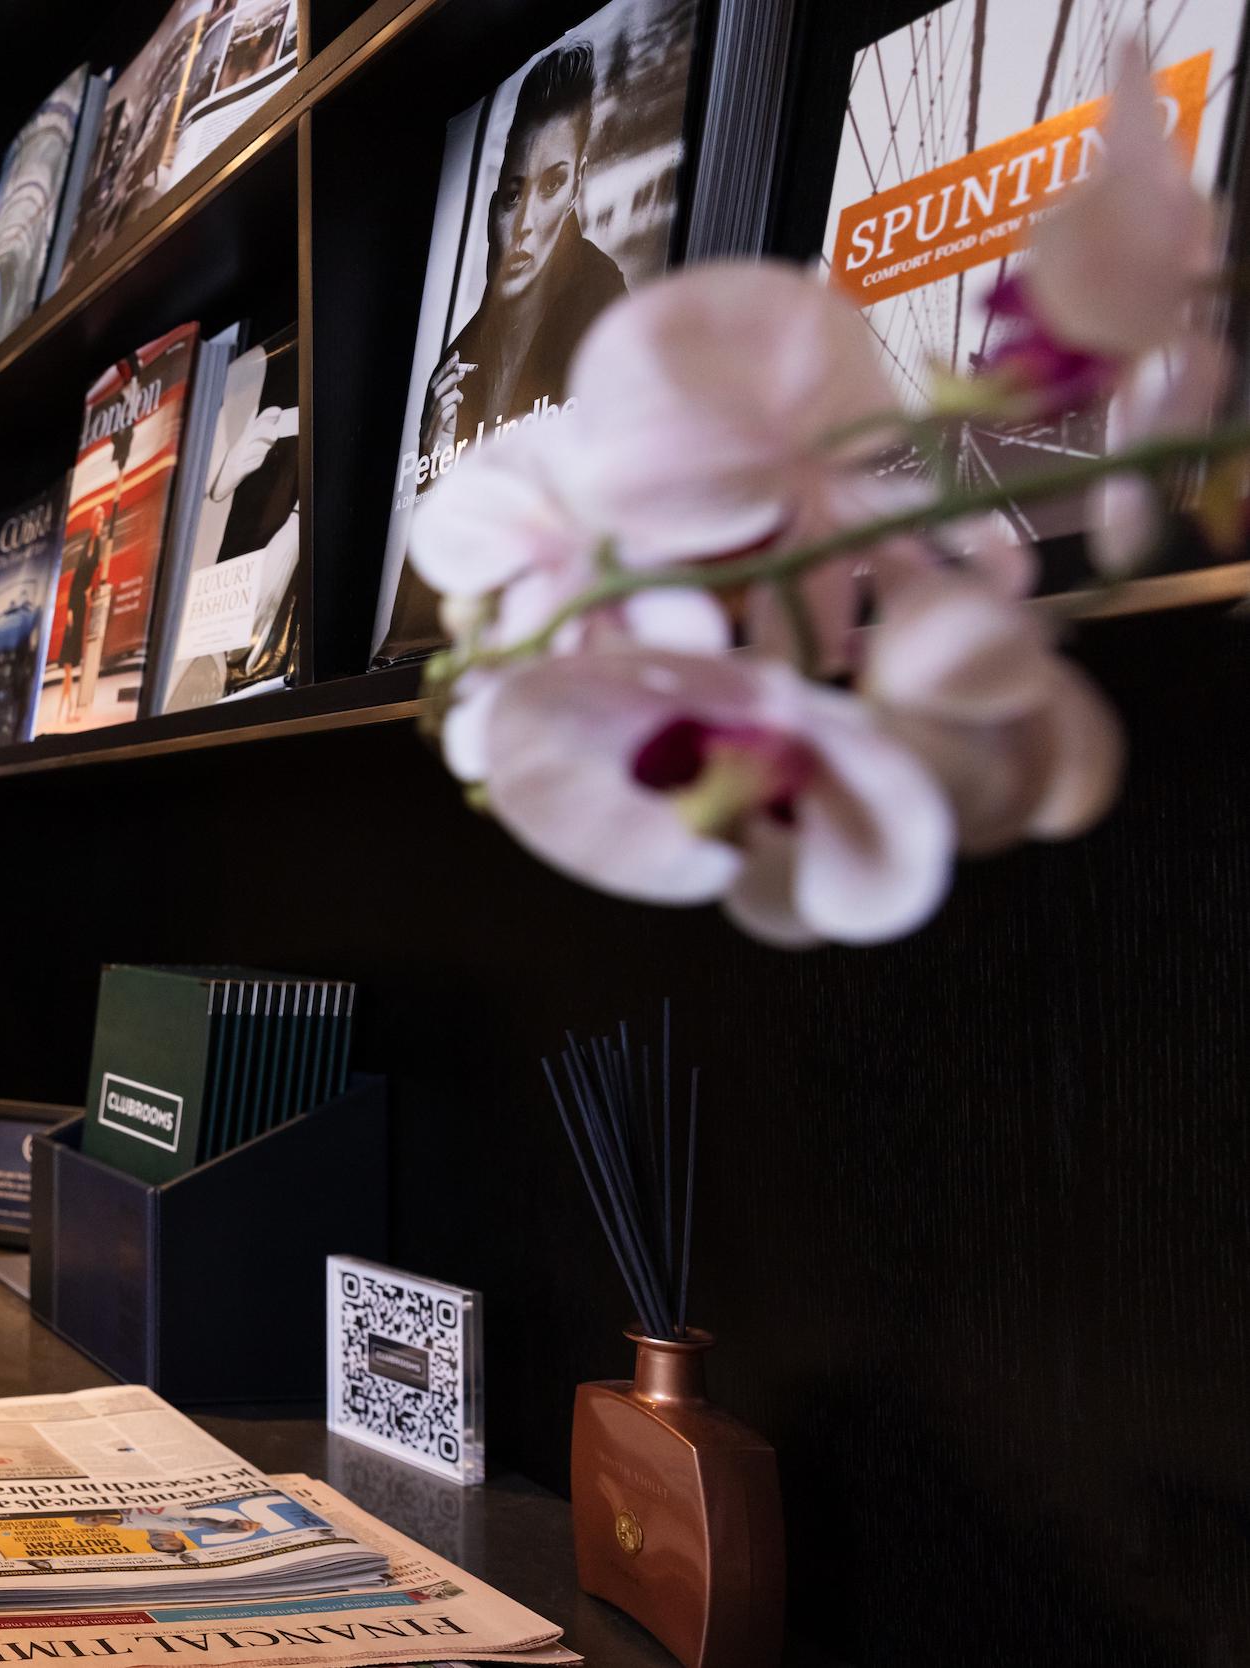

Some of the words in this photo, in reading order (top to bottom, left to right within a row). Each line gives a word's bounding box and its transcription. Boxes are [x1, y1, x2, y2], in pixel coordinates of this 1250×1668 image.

[862, 251, 932, 287] COMFORT
[934, 235, 978, 261] FOOD
[981, 216, 1024, 246] (NEW
[79, 376, 162, 451] London
[398, 437, 468, 493] Peter
[195, 561, 254, 597] LUXURY
[189, 586, 252, 621] FASHION
[107, 1090, 174, 1133] CLUBROOMS
[70, 1483, 99, 1498] in
[102, 1475, 213, 1496] research
[228, 1480, 271, 1491] UK
[15, 1496, 112, 1511] reveals
[116, 1485, 227, 1506] scientist
[23, 1538, 121, 1550] CHUTZPAH!
[25, 1546, 135, 1557] TOTTENHAM
[253, 1608, 300, 1616] Britain's
[342, 1600, 388, 1609] funding
[91, 1617, 145, 1626] Populism
[185, 1611, 252, 1620] universities
[134, 1617, 472, 1653] FINANCIAL
